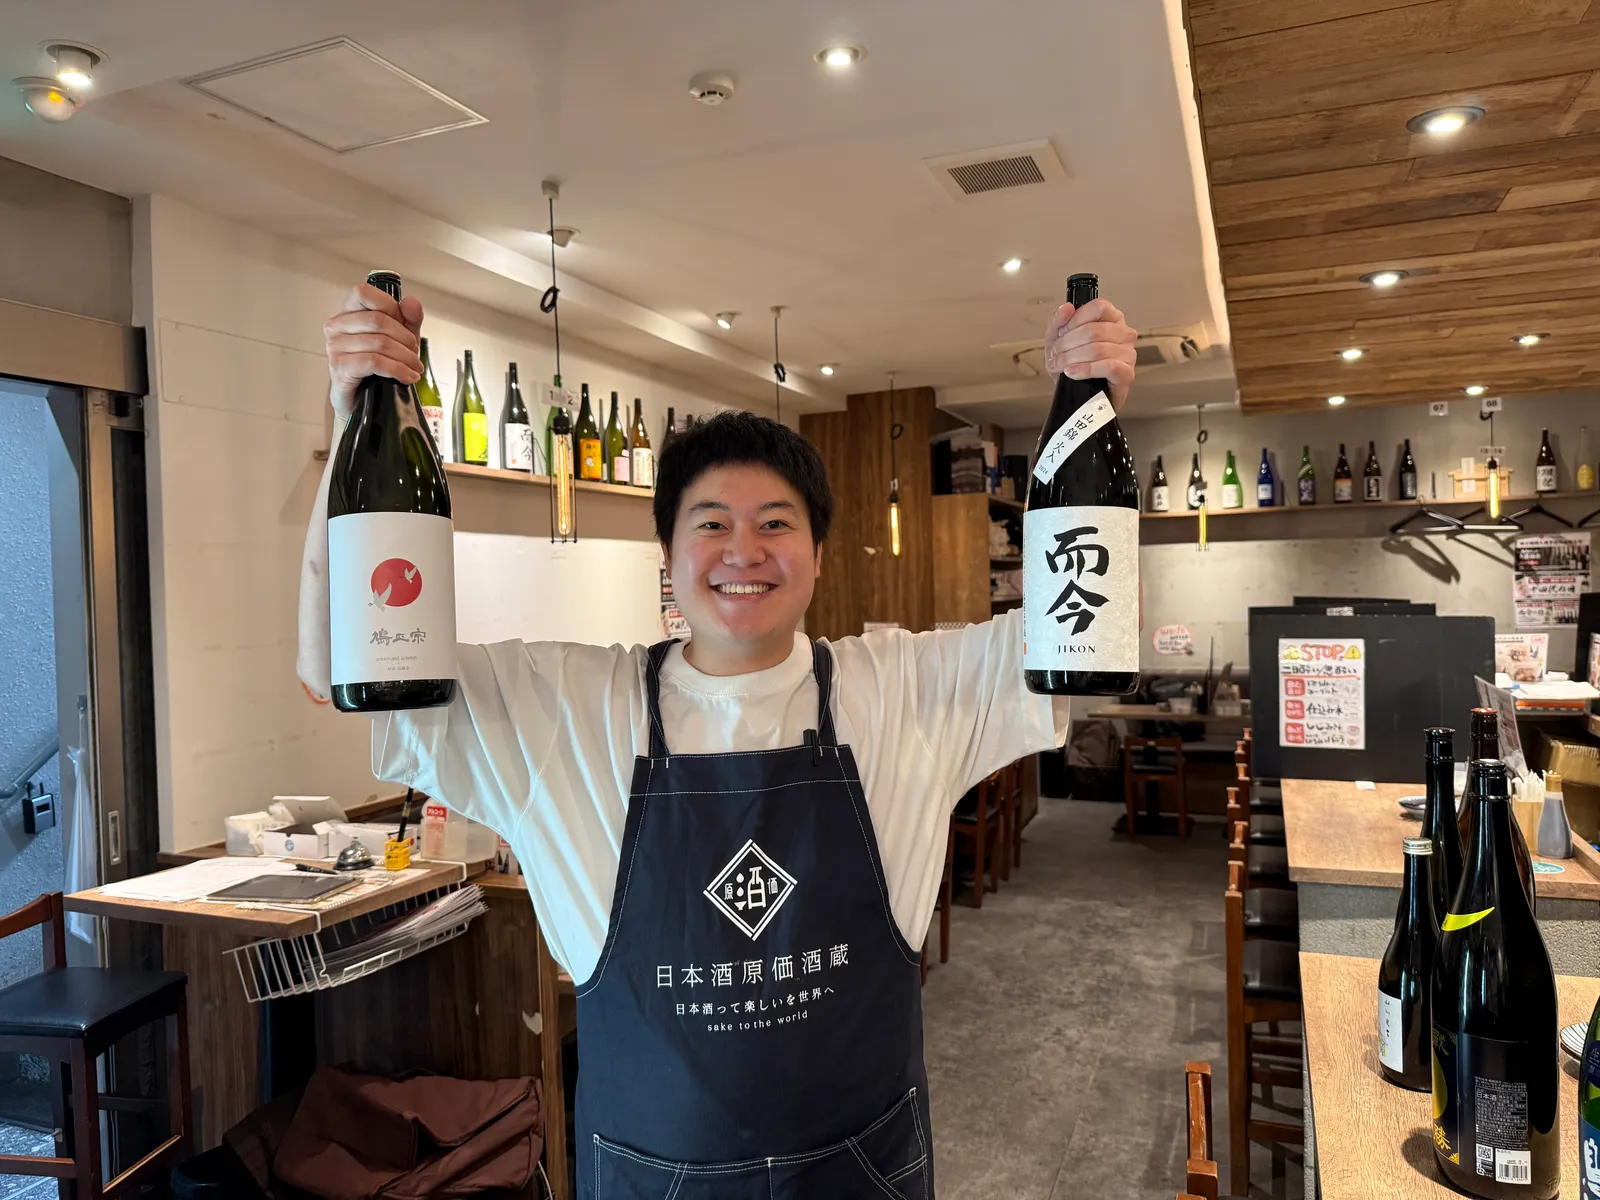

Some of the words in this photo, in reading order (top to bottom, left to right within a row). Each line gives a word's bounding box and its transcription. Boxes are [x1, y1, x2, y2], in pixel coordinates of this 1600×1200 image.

[1063, 413, 1094, 441] 山田錦
[1046, 441, 1065, 463] 火入
[1045, 526, 1110, 636] 而今
[370, 627, 427, 646] 鳩正宗
[1057, 644, 1096, 655] JIKON
[1301, 643, 1345, 661] STOP
[656, 943, 849, 989] 日本酒原価酒蔵
[676, 986, 834, 1016] 日本酒って楽しいを世界へ
[707, 1022, 733, 1032] sake
[777, 1009, 808, 1025] world
